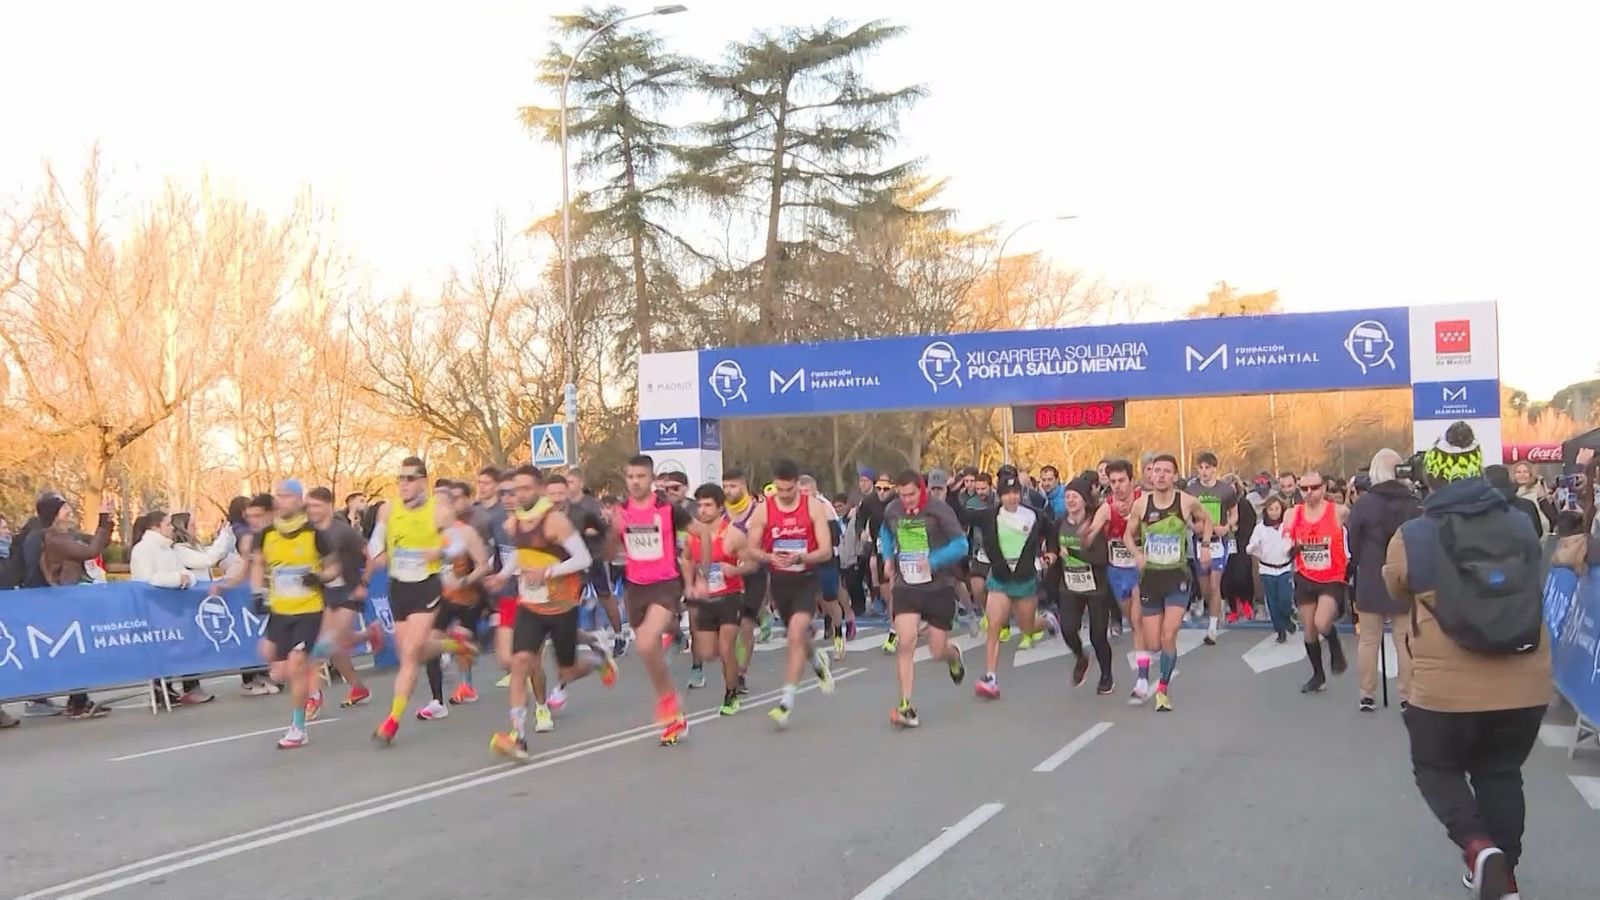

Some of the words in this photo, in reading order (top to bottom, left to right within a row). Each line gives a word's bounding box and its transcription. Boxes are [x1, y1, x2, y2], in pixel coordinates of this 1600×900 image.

[966, 351, 985, 366] XII
[987, 347, 1061, 364] CARRERA
[1064, 342, 1148, 360] SOLIDARIA
[1235, 344, 1284, 354] FUNDACIÓN
[1236, 352, 1320, 367] MANANTIAL
[811, 369, 852, 378] FUNDACIÓN
[969, 365, 1001, 380] POR
[1003, 363, 1024, 377] LA
[1026, 360, 1078, 376] SALUD
[1081, 356, 1147, 373] MENTAL
[811, 376, 881, 389] MANANTIAL
[91, 619, 148, 633] FUNDACIÓN
[94, 629, 185, 649] MANANTIAL
